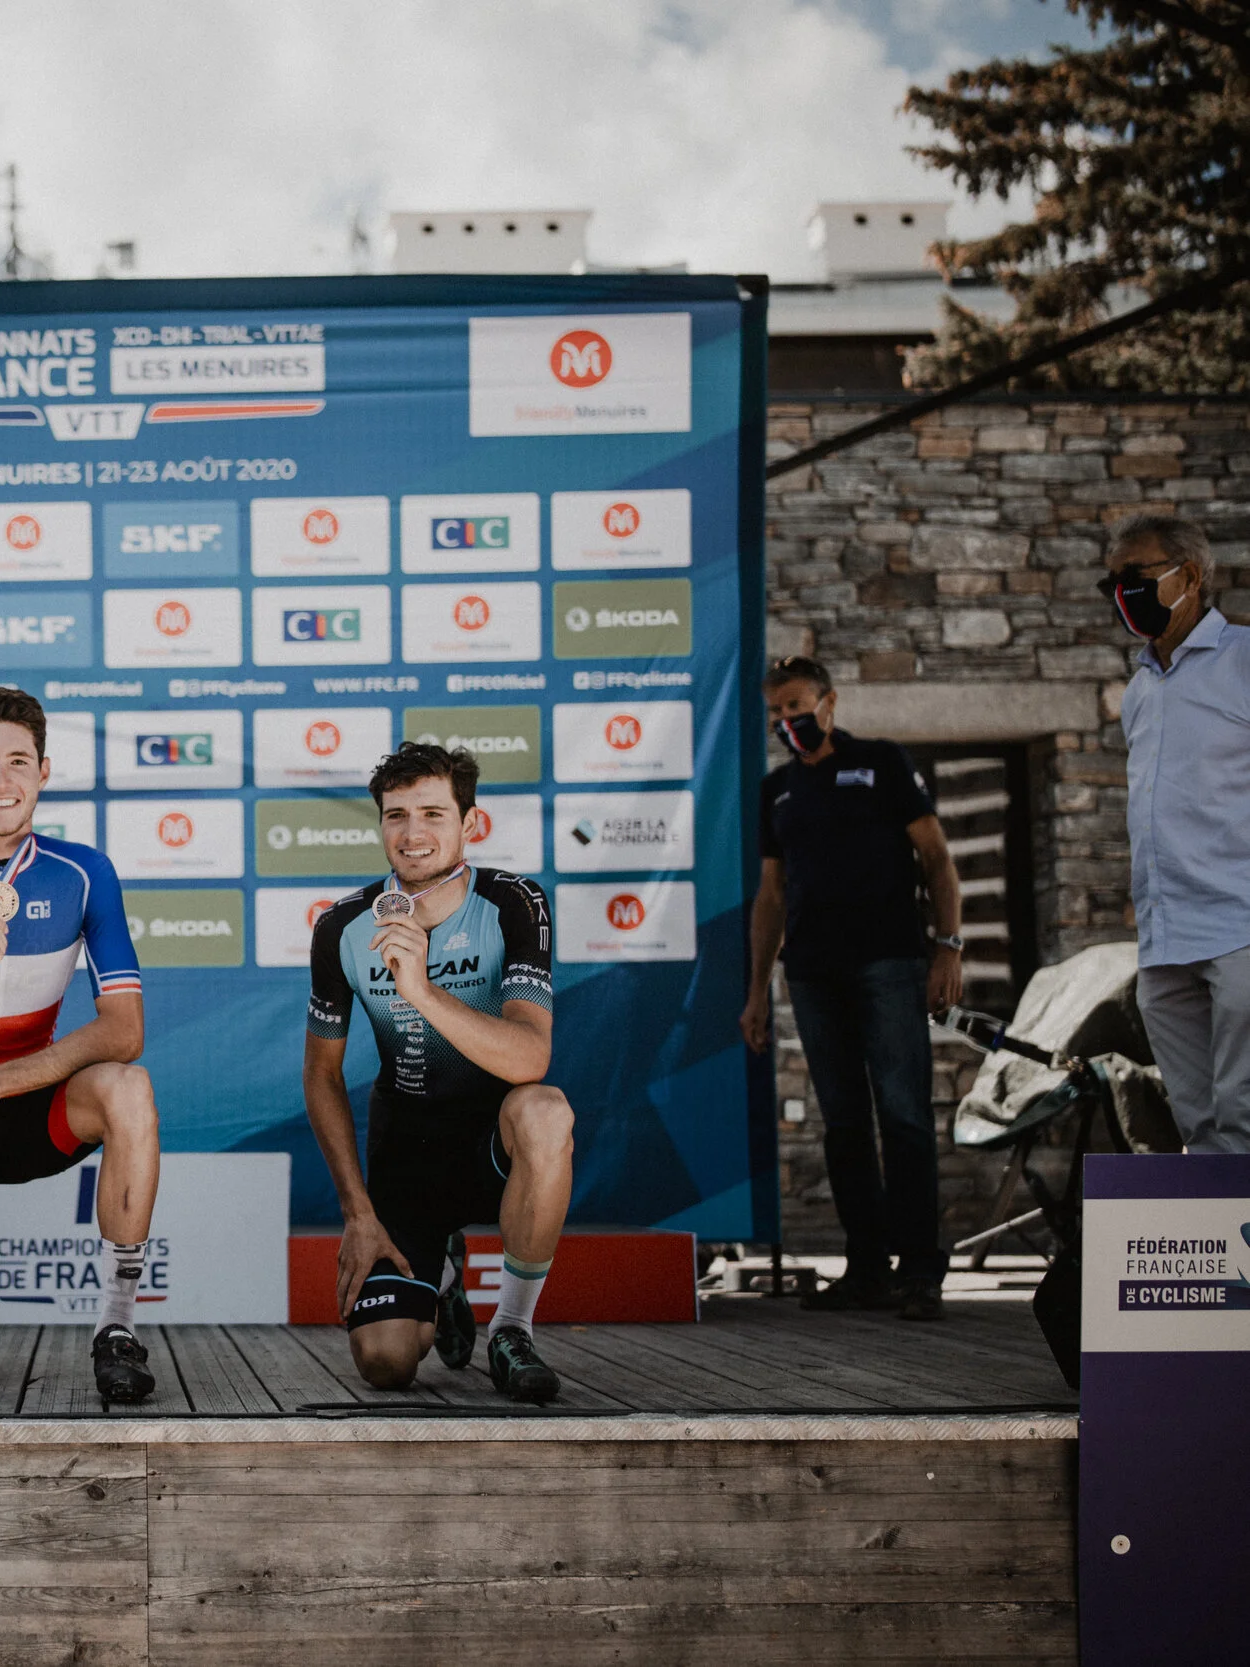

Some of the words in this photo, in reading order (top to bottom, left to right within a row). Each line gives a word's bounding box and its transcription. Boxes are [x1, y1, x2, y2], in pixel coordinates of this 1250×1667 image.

[126, 360, 170, 380] LES
[181, 357, 310, 378] MENUIRES
[67, 411, 126, 433] VTT
[97, 460, 159, 483] 21-23
[161, 455, 232, 482] AOÛT
[236, 458, 298, 481] 2020
[120, 523, 222, 553] SKF
[436, 518, 506, 548] CIC
[287, 611, 356, 641] CIC
[140, 735, 209, 765] CIC
[493, 871, 550, 952] DUKE
[1127, 1236, 1226, 1254] FÉDÉRATION
[35, 1261, 169, 1289] FRAE
[1126, 1259, 1226, 1278] FRANÇAISE
[68, 1297, 98, 1311] VTT
[1126, 1287, 1136, 1304] DE
[1139, 1287, 1226, 1304] CYCLISME
